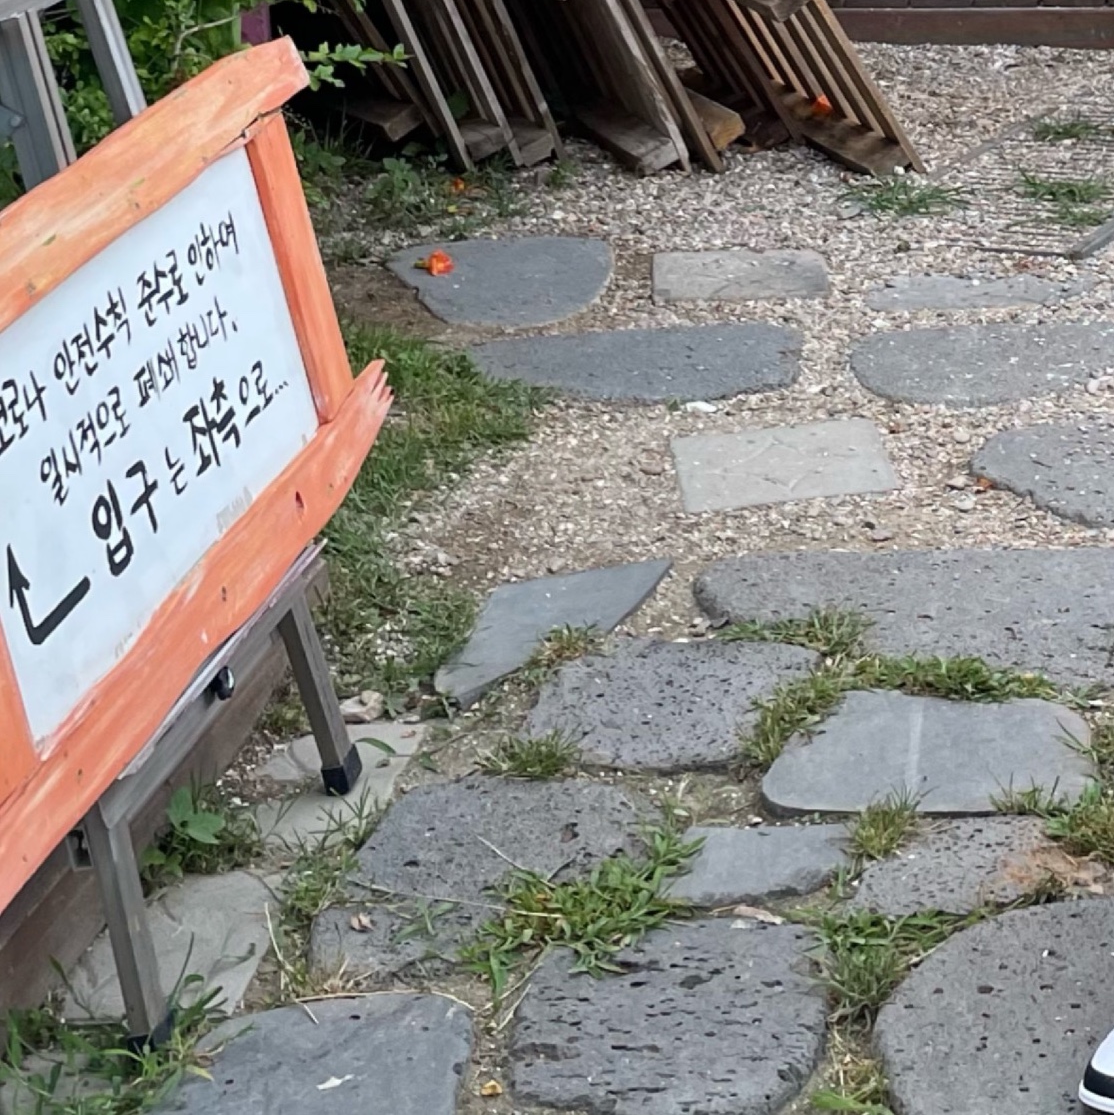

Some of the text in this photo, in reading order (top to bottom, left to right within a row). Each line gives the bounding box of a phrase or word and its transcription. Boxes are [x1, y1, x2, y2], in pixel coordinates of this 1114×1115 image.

[53, 286, 131, 395] 안전수칙
[136, 248, 189, 326] 준수로
[187, 210, 239, 286] 인하여
[40, 386, 131, 506] 일시적으로
